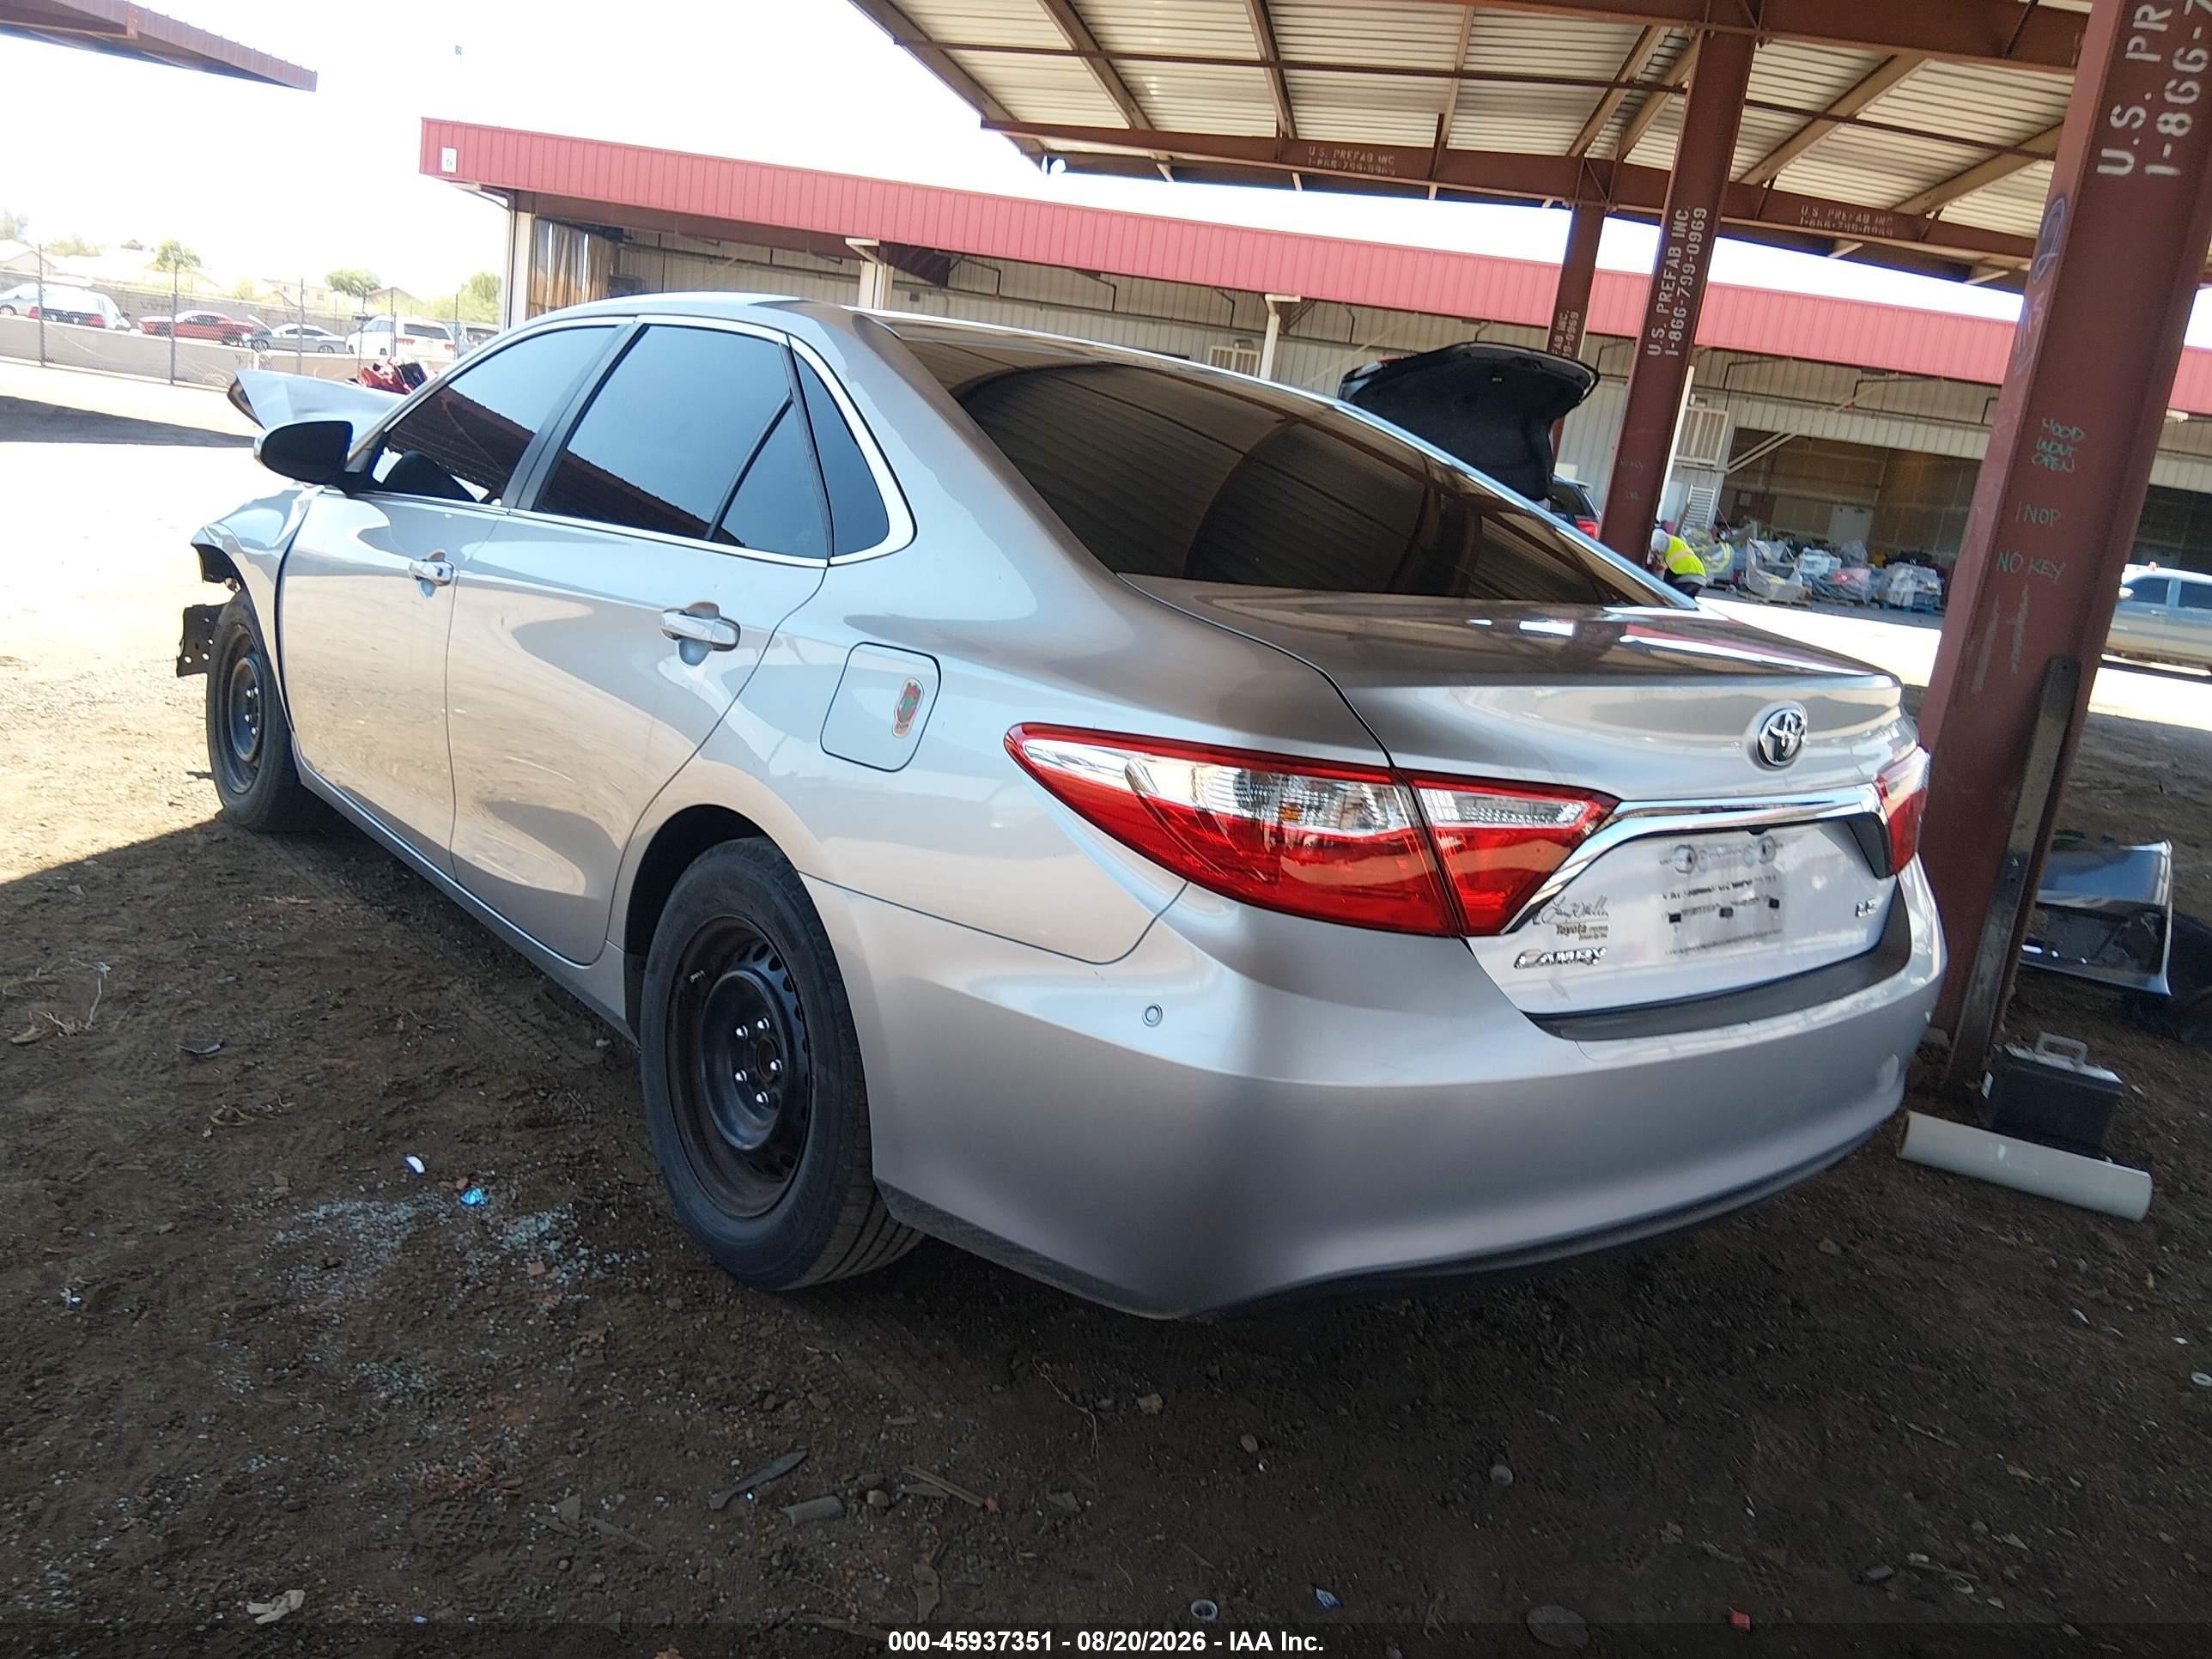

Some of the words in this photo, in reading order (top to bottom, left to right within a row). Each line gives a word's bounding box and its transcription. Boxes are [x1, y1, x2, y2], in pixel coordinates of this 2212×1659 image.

[2096, 92, 2152, 176] U.S.
[1656, 246, 1682, 314] PREFAB
[1665, 207, 1708, 357] 1-866-799-0969
[1647, 322, 1668, 357] U.S.
[1996, 551, 2024, 574] NO
[2027, 557, 2068, 585] KEY
